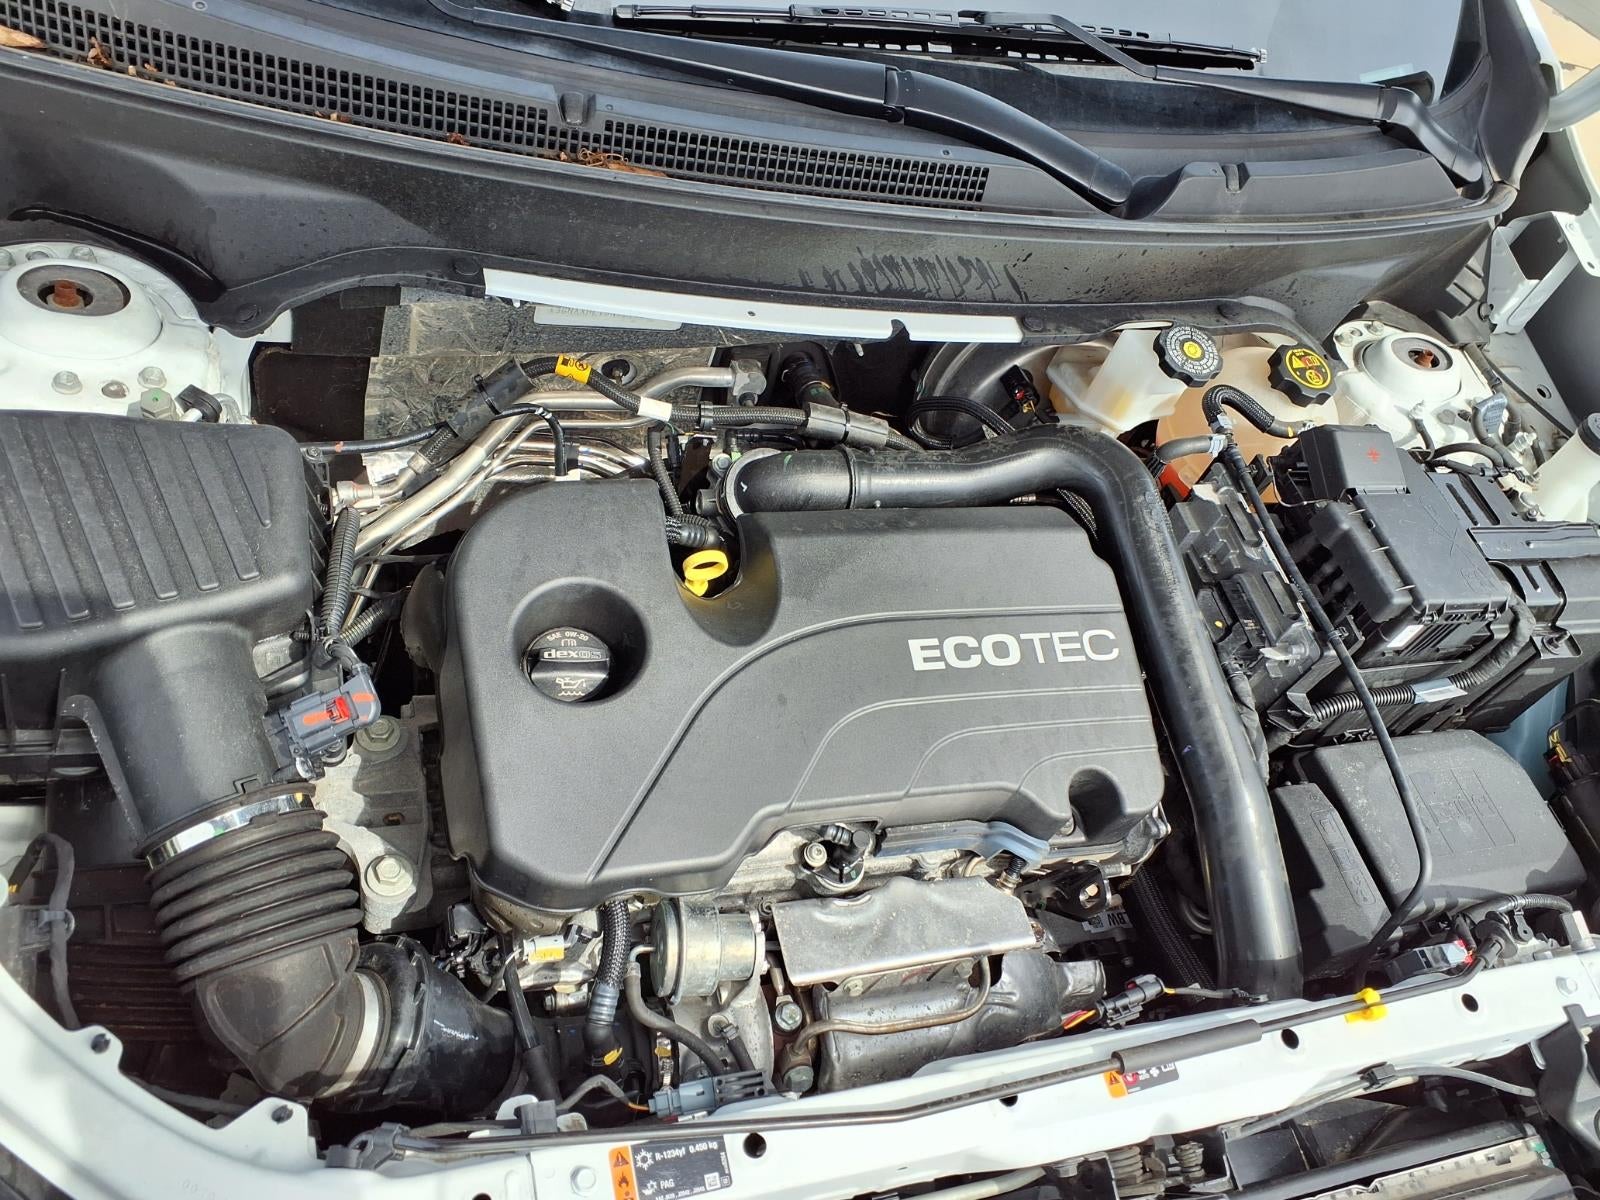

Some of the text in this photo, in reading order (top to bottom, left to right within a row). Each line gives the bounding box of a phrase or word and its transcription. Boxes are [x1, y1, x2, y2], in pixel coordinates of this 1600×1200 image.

[546, 631, 589, 642] SAE 0W-20
[543, 649, 602, 659] dexos
[908, 629, 1119, 671] ECOTEC
[655, 1146, 686, 1161] R-1234yf
[708, 1141, 718, 1150] kg
[659, 1178, 675, 1190] PAG
